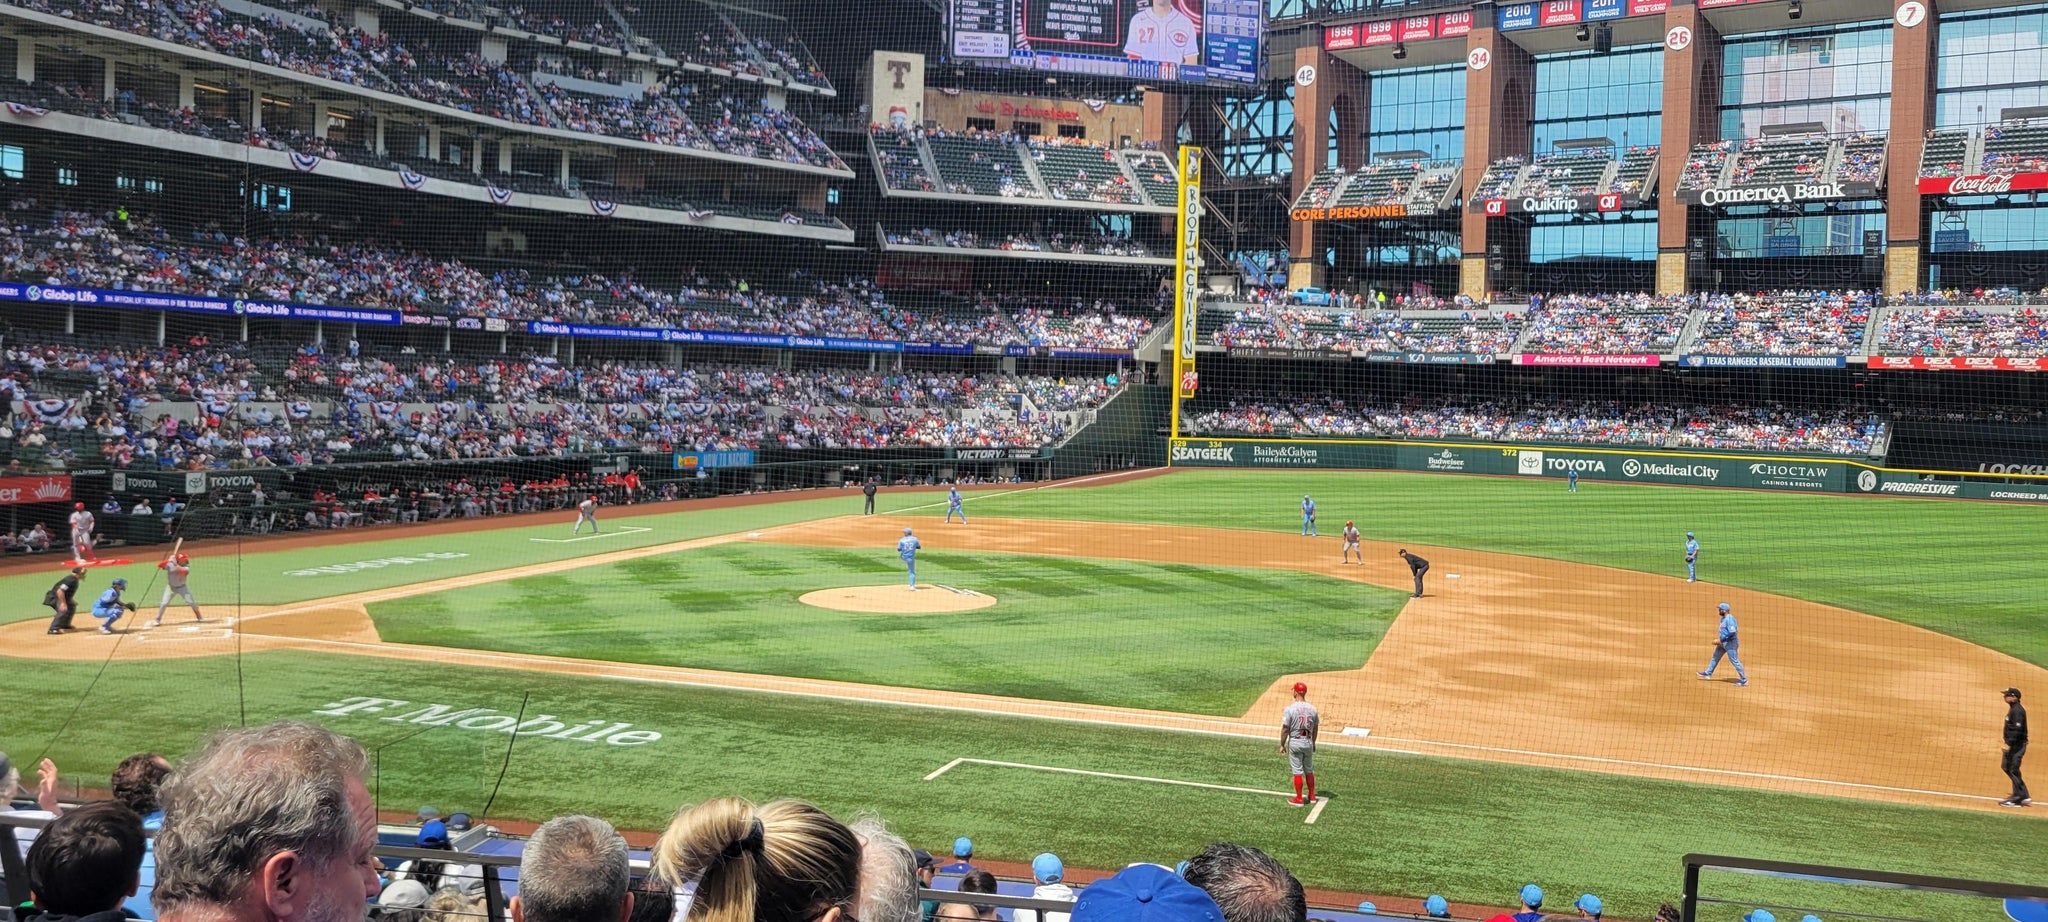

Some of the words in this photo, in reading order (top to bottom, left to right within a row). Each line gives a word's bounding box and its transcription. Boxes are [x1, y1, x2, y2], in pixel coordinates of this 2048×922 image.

[1505, 6, 1531, 18] 2010
[1550, 1, 1573, 13] 2011
[1445, 12, 1470, 25] 2010
[1905, 7, 1917, 22] 7
[1369, 22, 1391, 34] 1998
[1405, 17, 1429, 29] 1999
[1139, 27, 1154, 44] 27
[1331, 27, 1353, 38] 1996
[1669, 31, 1688, 45] 26
[1471, 52, 1487, 65] 34
[887, 59, 912, 89] T
[1298, 69, 1313, 82] 42
[1000, 101, 1079, 120] Budweiser
[1793, 181, 1846, 200] Bank
[1948, 174, 2015, 194] Coca-Cola
[1486, 201, 1502, 214] QT
[1522, 197, 1578, 212] QuikTrip
[1600, 195, 1617, 208] QT
[1186, 187, 1197, 245] ROOT
[1292, 208, 1325, 221] CORE
[1328, 205, 1406, 219] PERSONNEL
[1407, 208, 1434, 216] SERVICES
[1186, 252, 1196, 265] 4
[42, 288, 76, 301] Globe
[76, 291, 98, 303] Life
[246, 303, 272, 314] Globe
[273, 304, 290, 316] Life
[1184, 273, 1195, 355] CHIKIN
[541, 324, 559, 333] Globe
[559, 325, 570, 334] Life
[671, 331, 692, 340] Globe
[693, 332, 704, 341] Life
[796, 337, 814, 346] Globe
[813, 338, 825, 346] Life
[1534, 355, 1580, 363] America's
[1582, 355, 1599, 363] Best
[1606, 356, 1648, 364] Network
[1706, 356, 1727, 365] TEXAS
[1727, 357, 1758, 366] RANGERS
[1759, 357, 1791, 366] BASEBALL
[1793, 357, 1837, 366] FOUNDATION
[1882, 357, 1913, 365] DEX
[1923, 357, 1954, 365] DEX
[1965, 357, 1996, 366] DEX
[2007, 358, 2038, 366] DEX
[957, 449, 1002, 459] VICTORY
[1172, 446, 1234, 462] SEATGEEK
[1253, 445, 1317, 459] Bailey&Galyen
[1502, 449, 1517, 457] 372
[1428, 456, 1465, 466] Budweiser
[1546, 458, 1606, 473] TOYOTA
[1643, 463, 1692, 477] Medical
[1693, 465, 1719, 481] City
[1757, 463, 1828, 477] CHOCTAW
[127, 479, 158, 488] TOYOTA
[210, 476, 255, 487] TOYOTA
[0, 487, 21, 501] er
[1881, 482, 1958, 495] PROGRESSIVE
[1990, 491, 2037, 499] LOCKHEED
[1298, 716, 1312, 729] 75
